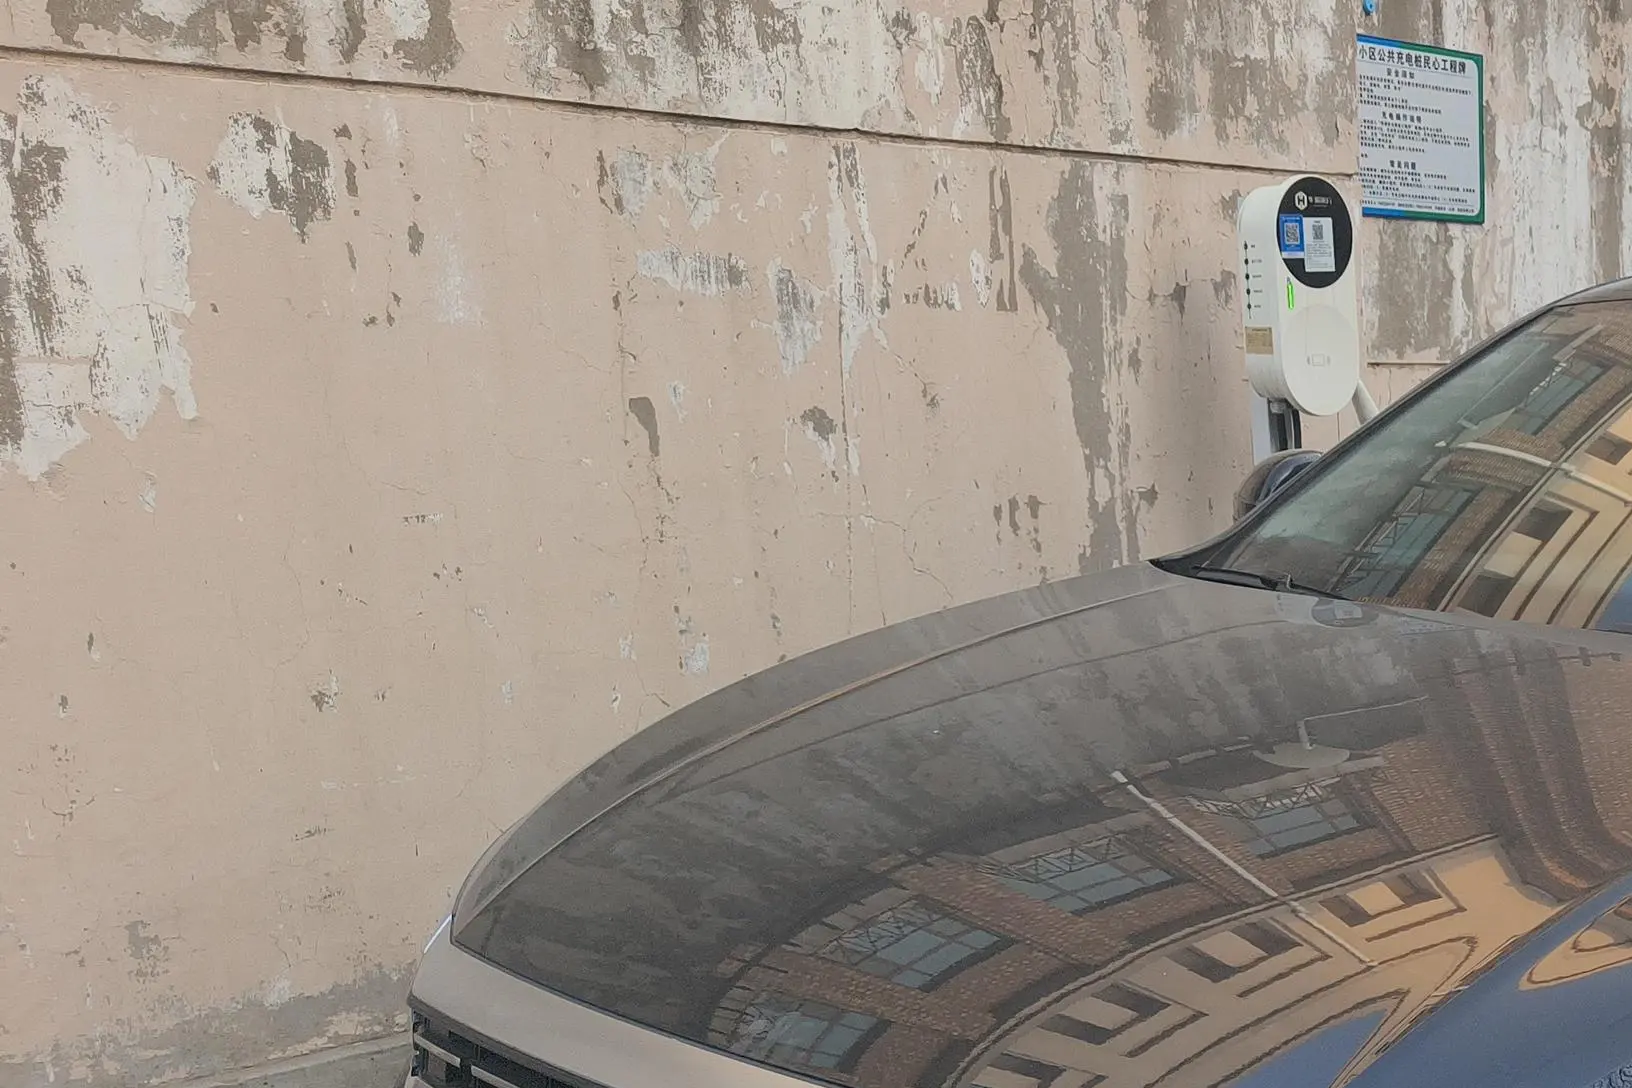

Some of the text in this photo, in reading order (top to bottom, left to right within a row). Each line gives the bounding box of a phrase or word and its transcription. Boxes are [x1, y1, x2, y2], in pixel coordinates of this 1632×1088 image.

[1359, 44, 1466, 74] 小区公共充电桩民心工程牌
